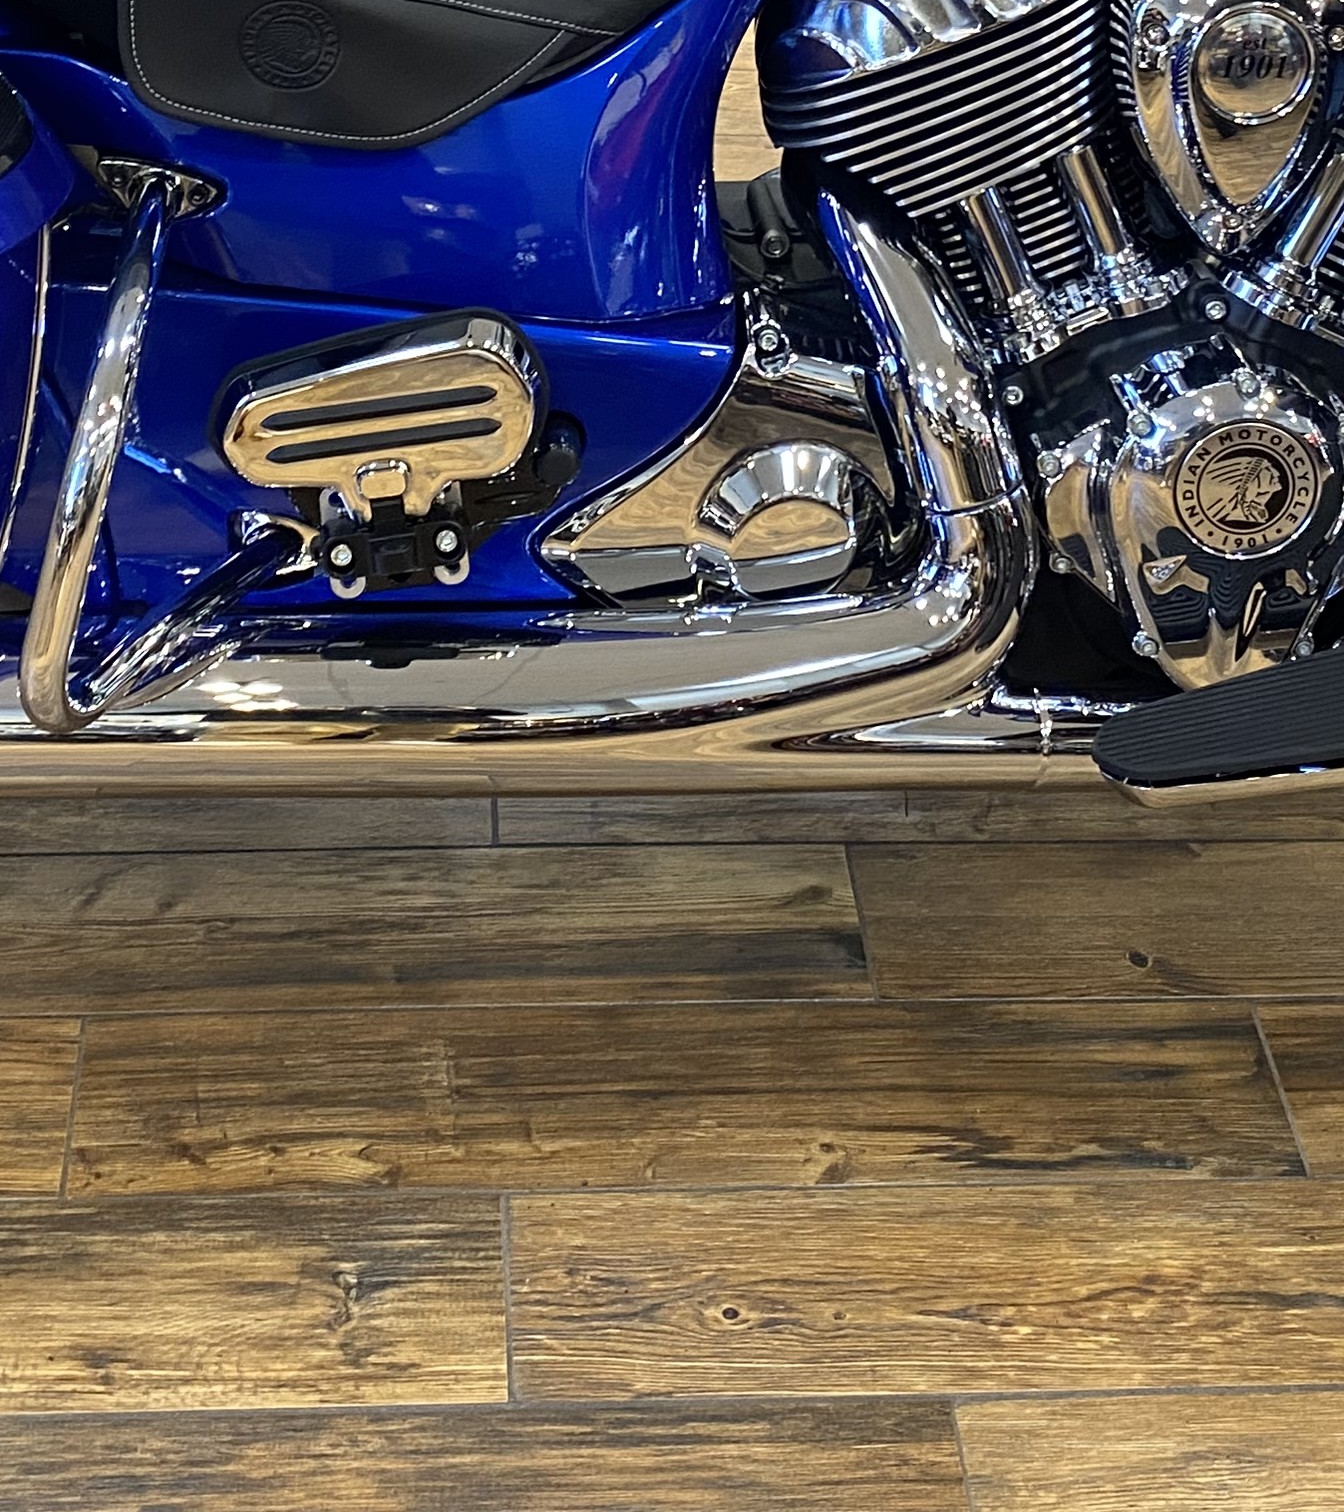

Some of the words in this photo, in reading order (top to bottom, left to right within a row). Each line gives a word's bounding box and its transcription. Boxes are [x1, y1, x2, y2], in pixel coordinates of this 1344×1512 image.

[1243, 37, 1267, 50] est
[1222, 55, 1288, 79] 1901
[1183, 446, 1213, 528] INDIAN
[1218, 428, 1311, 525] MOTORCYCLE
[1222, 534, 1270, 549] 1901
